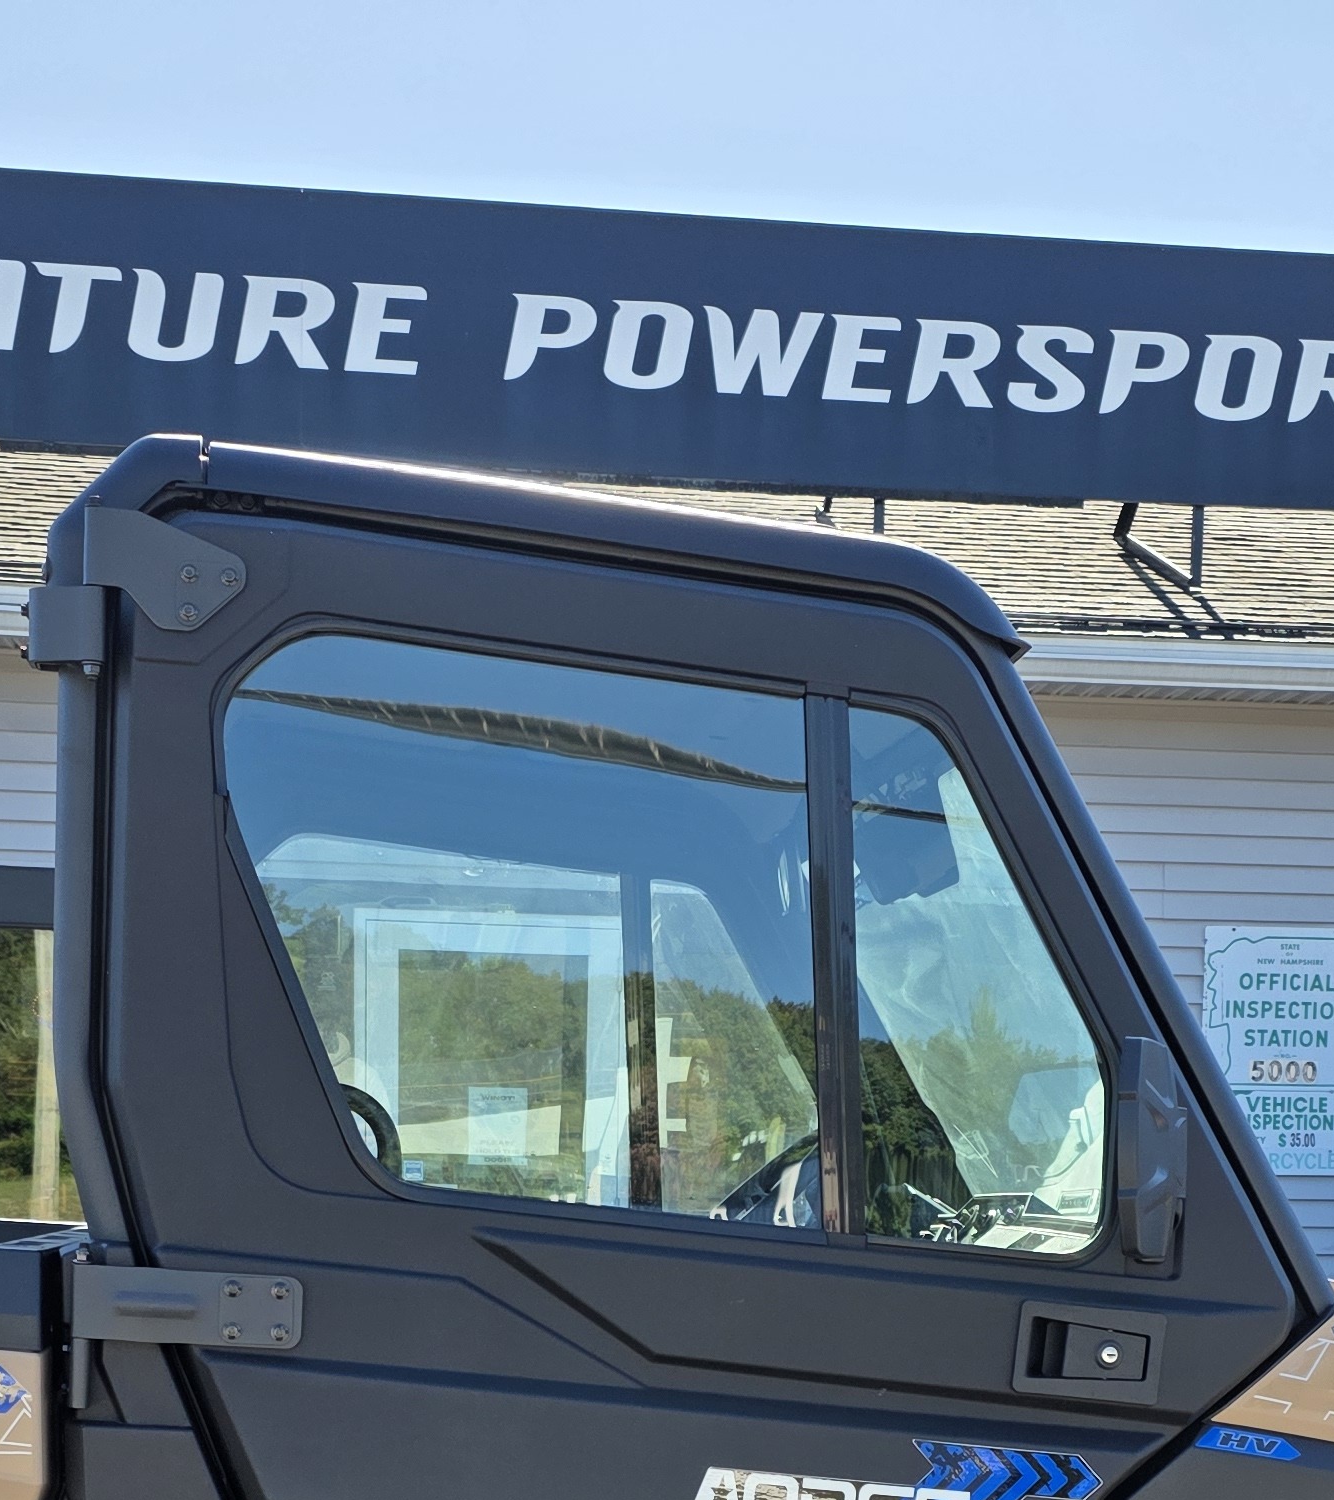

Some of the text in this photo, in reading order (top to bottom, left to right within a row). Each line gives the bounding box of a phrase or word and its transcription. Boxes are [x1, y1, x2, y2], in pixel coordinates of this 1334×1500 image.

[1280, 943, 1301, 951] STATE
[1257, 957, 1325, 966] NEW HAMPSHIRE
[1243, 1028, 1329, 1048] STATION
[1251, 1060, 1317, 1083] 5000
[1246, 1096, 1329, 1114] VEHICLE
[1247, 1113, 1334, 1131] SPECTION
